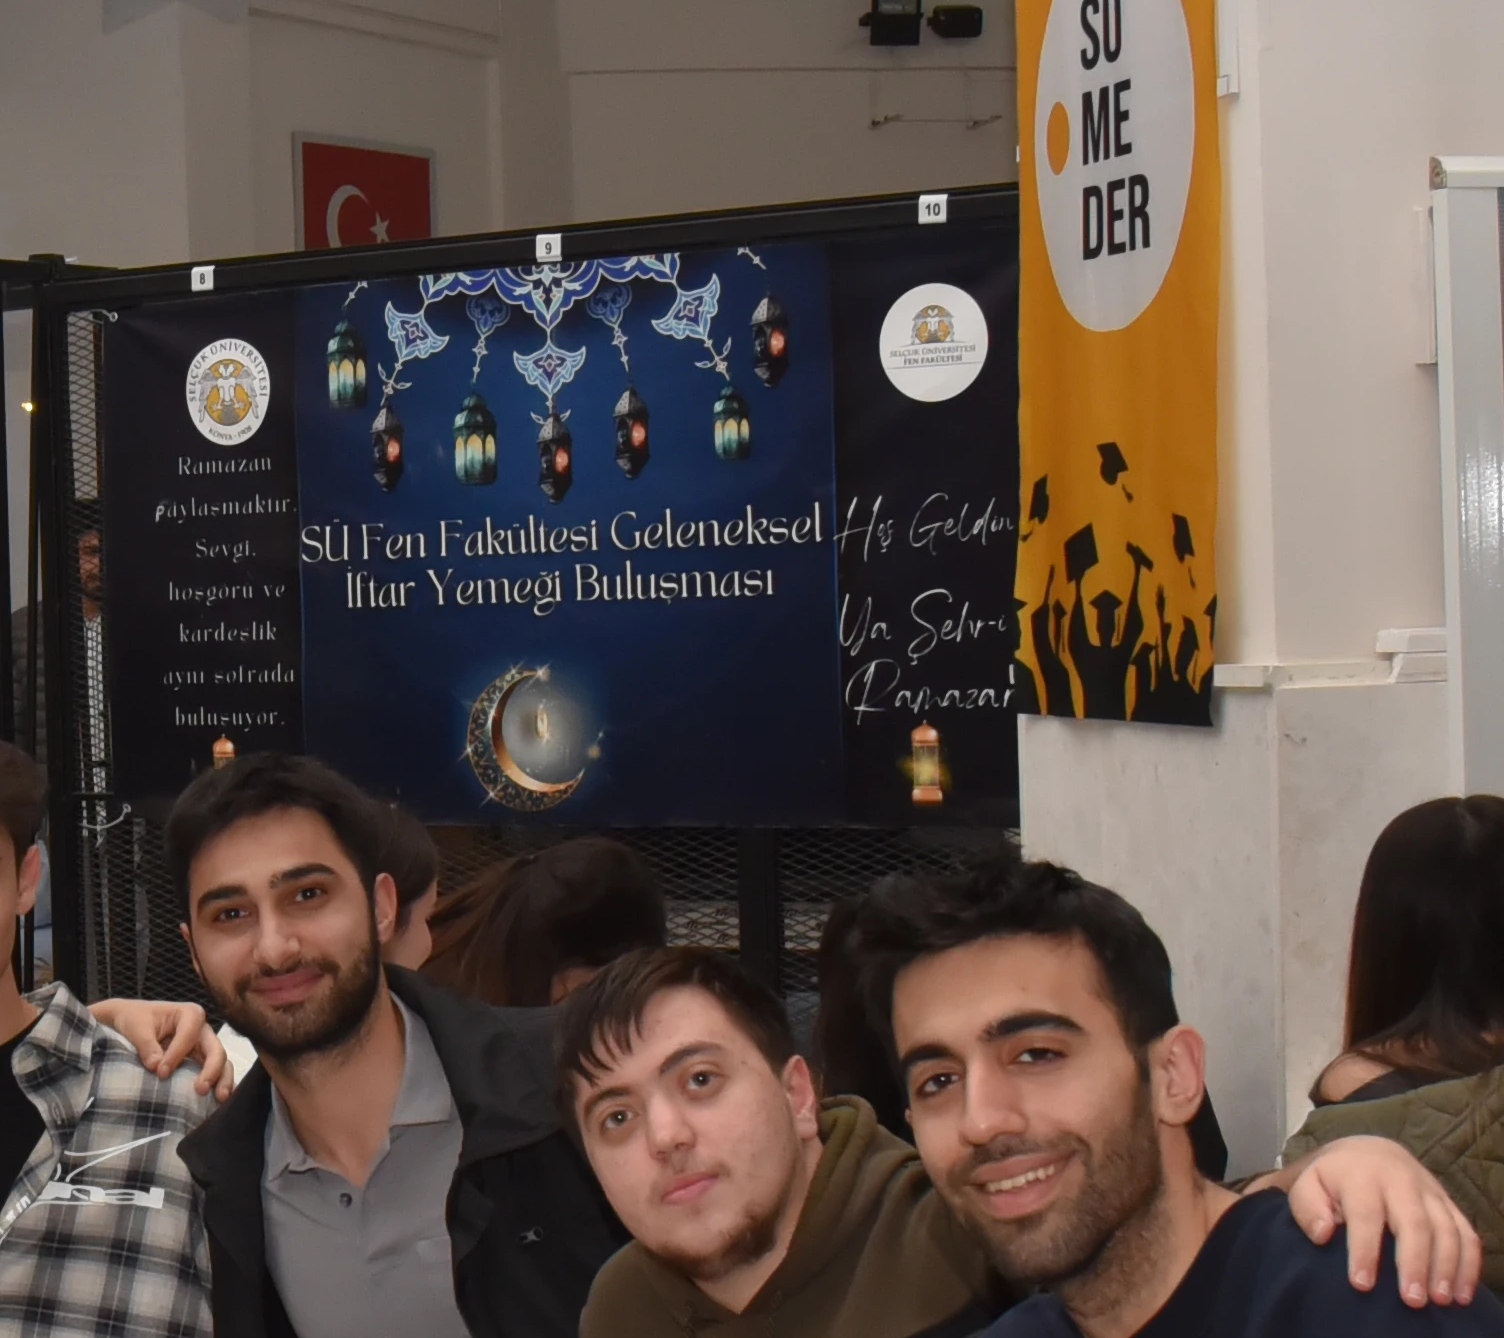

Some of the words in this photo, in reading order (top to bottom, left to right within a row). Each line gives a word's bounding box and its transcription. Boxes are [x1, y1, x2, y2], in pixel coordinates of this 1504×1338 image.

[1081, 77, 1132, 166] ME
[925, 202, 941, 217] 10
[1082, 173, 1151, 261] DER
[544, 242, 552, 255] 9
[199, 272, 206, 285] 8
[178, 456, 272, 476] Ramazan
[301, 518, 349, 563] SÜ
[361, 523, 426, 560] Fen
[439, 513, 599, 558] Fakültesi
[610, 501, 824, 551] Geleneksel
[833, 494, 894, 563] Hoş
[909, 492, 1015, 556] Geldin
[263, 583, 286, 598] ve
[346, 565, 416, 609] İftar
[426, 567, 563, 617] Yemeği
[574, 559, 775, 606] Buluşması
[179, 620, 278, 644] kardeşlik
[839, 593, 892, 657] Ya
[163, 670, 205, 691] aynı
[214, 662, 295, 684] sofrada
